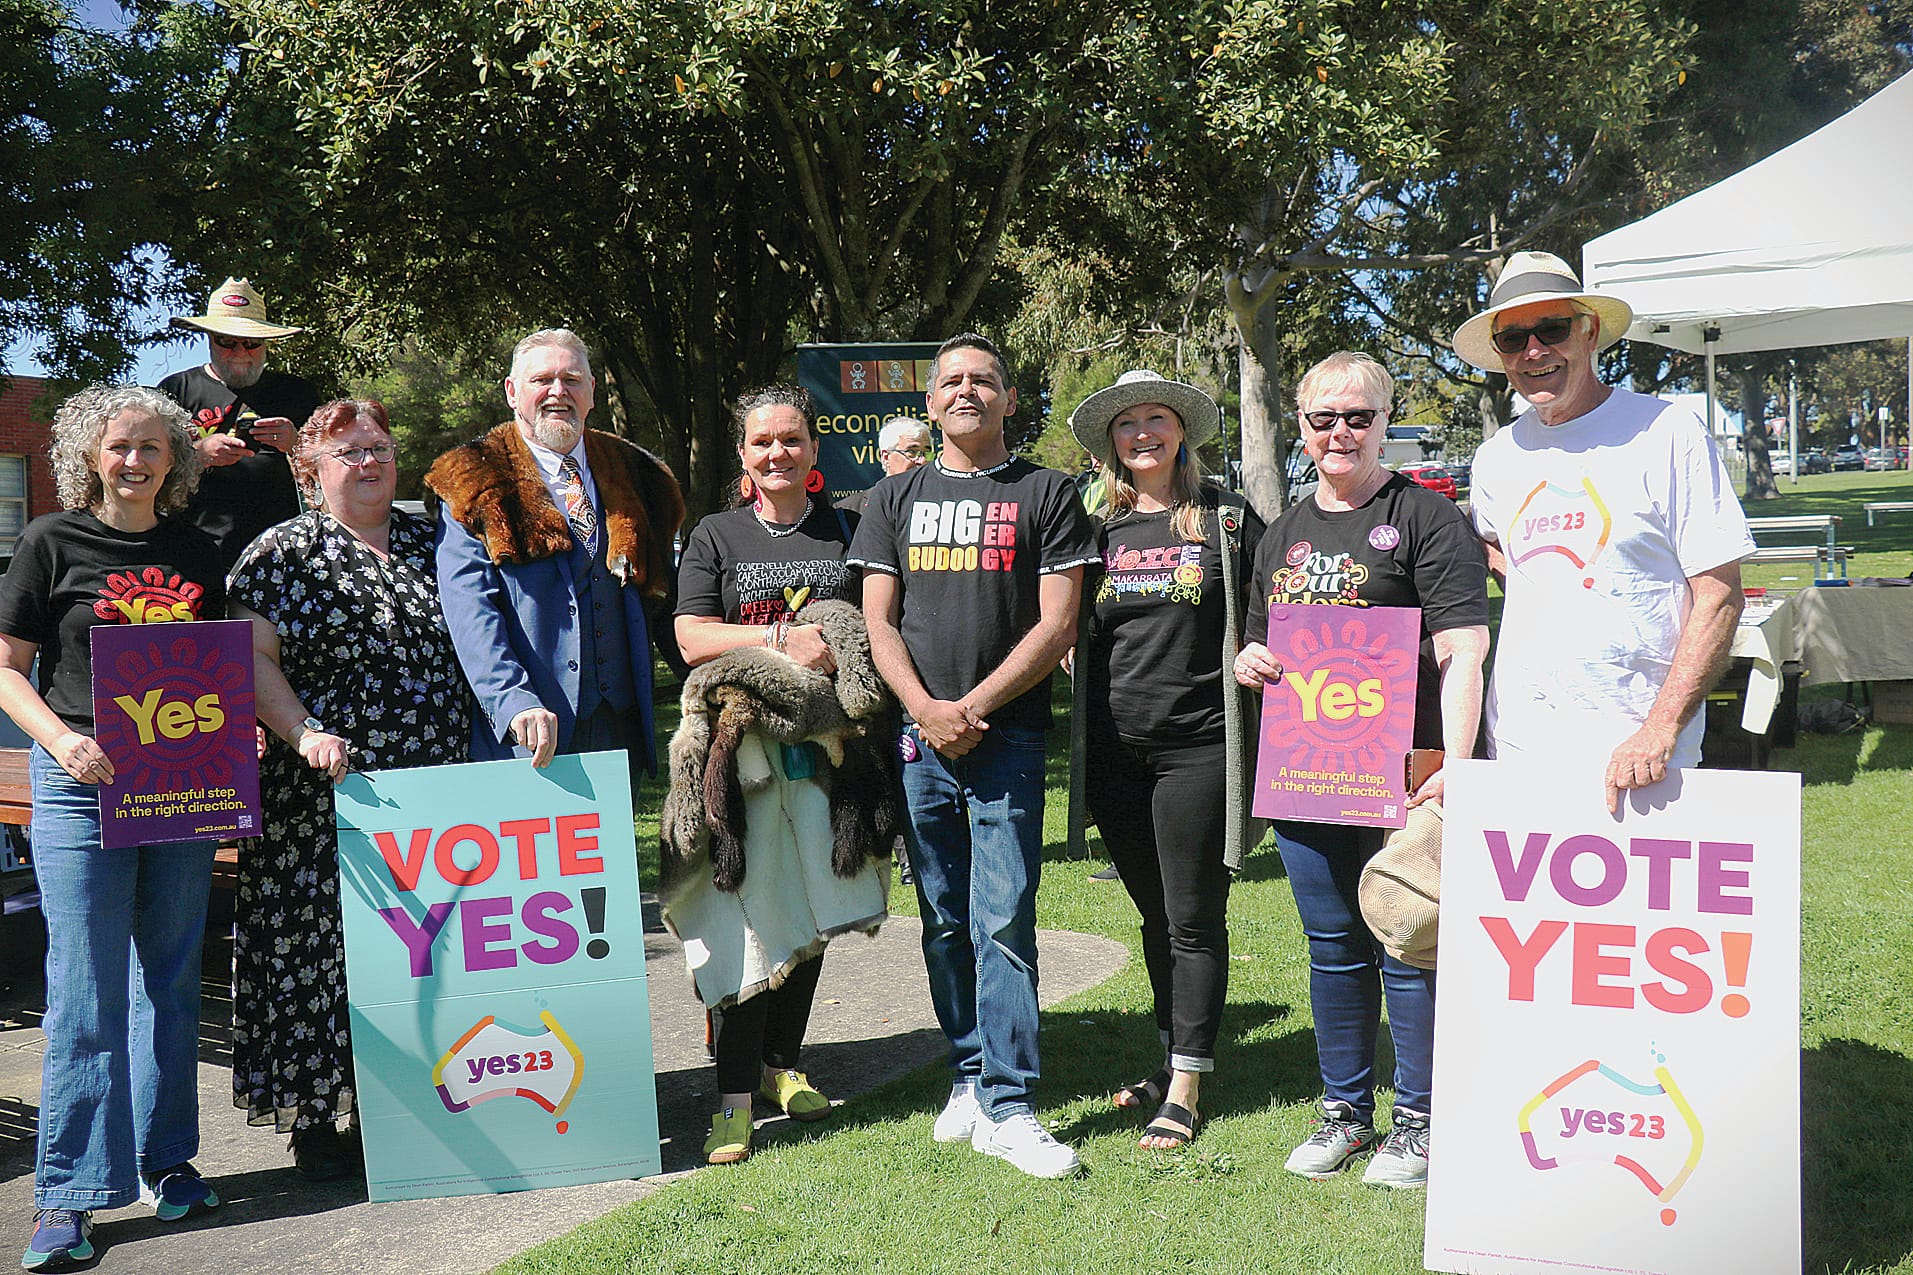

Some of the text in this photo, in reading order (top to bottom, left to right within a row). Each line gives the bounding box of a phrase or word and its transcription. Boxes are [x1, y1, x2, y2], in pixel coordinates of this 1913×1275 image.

[909, 500, 982, 545] BIG
[985, 502, 1019, 522] EN
[983, 524, 1016, 547] ER
[1523, 511, 1585, 541] yes23
[908, 545, 979, 572] BUDOO
[981, 548, 1016, 572] GY
[1299, 550, 1350, 574] For
[1112, 572, 1173, 584] MAKARRATA
[1285, 571, 1350, 593] Our
[111, 598, 194, 625] Yes
[740, 600, 774, 616] CREEK
[1284, 668, 1385, 722] Yes
[113, 688, 225, 745] Yes
[1271, 779, 1394, 798] in the right direction.
[1279, 767, 1386, 787] A meaningful step
[115, 799, 247, 819] in the right direction.
[122, 787, 236, 805] A meaningful step
[373, 812, 605, 892] VOTE
[1483, 830, 1754, 915] VOTE
[378, 887, 610, 978] YES!
[1479, 916, 1753, 1018] YES!
[466, 1050, 554, 1084] yes23
[1559, 1107, 1666, 1139] yes23
